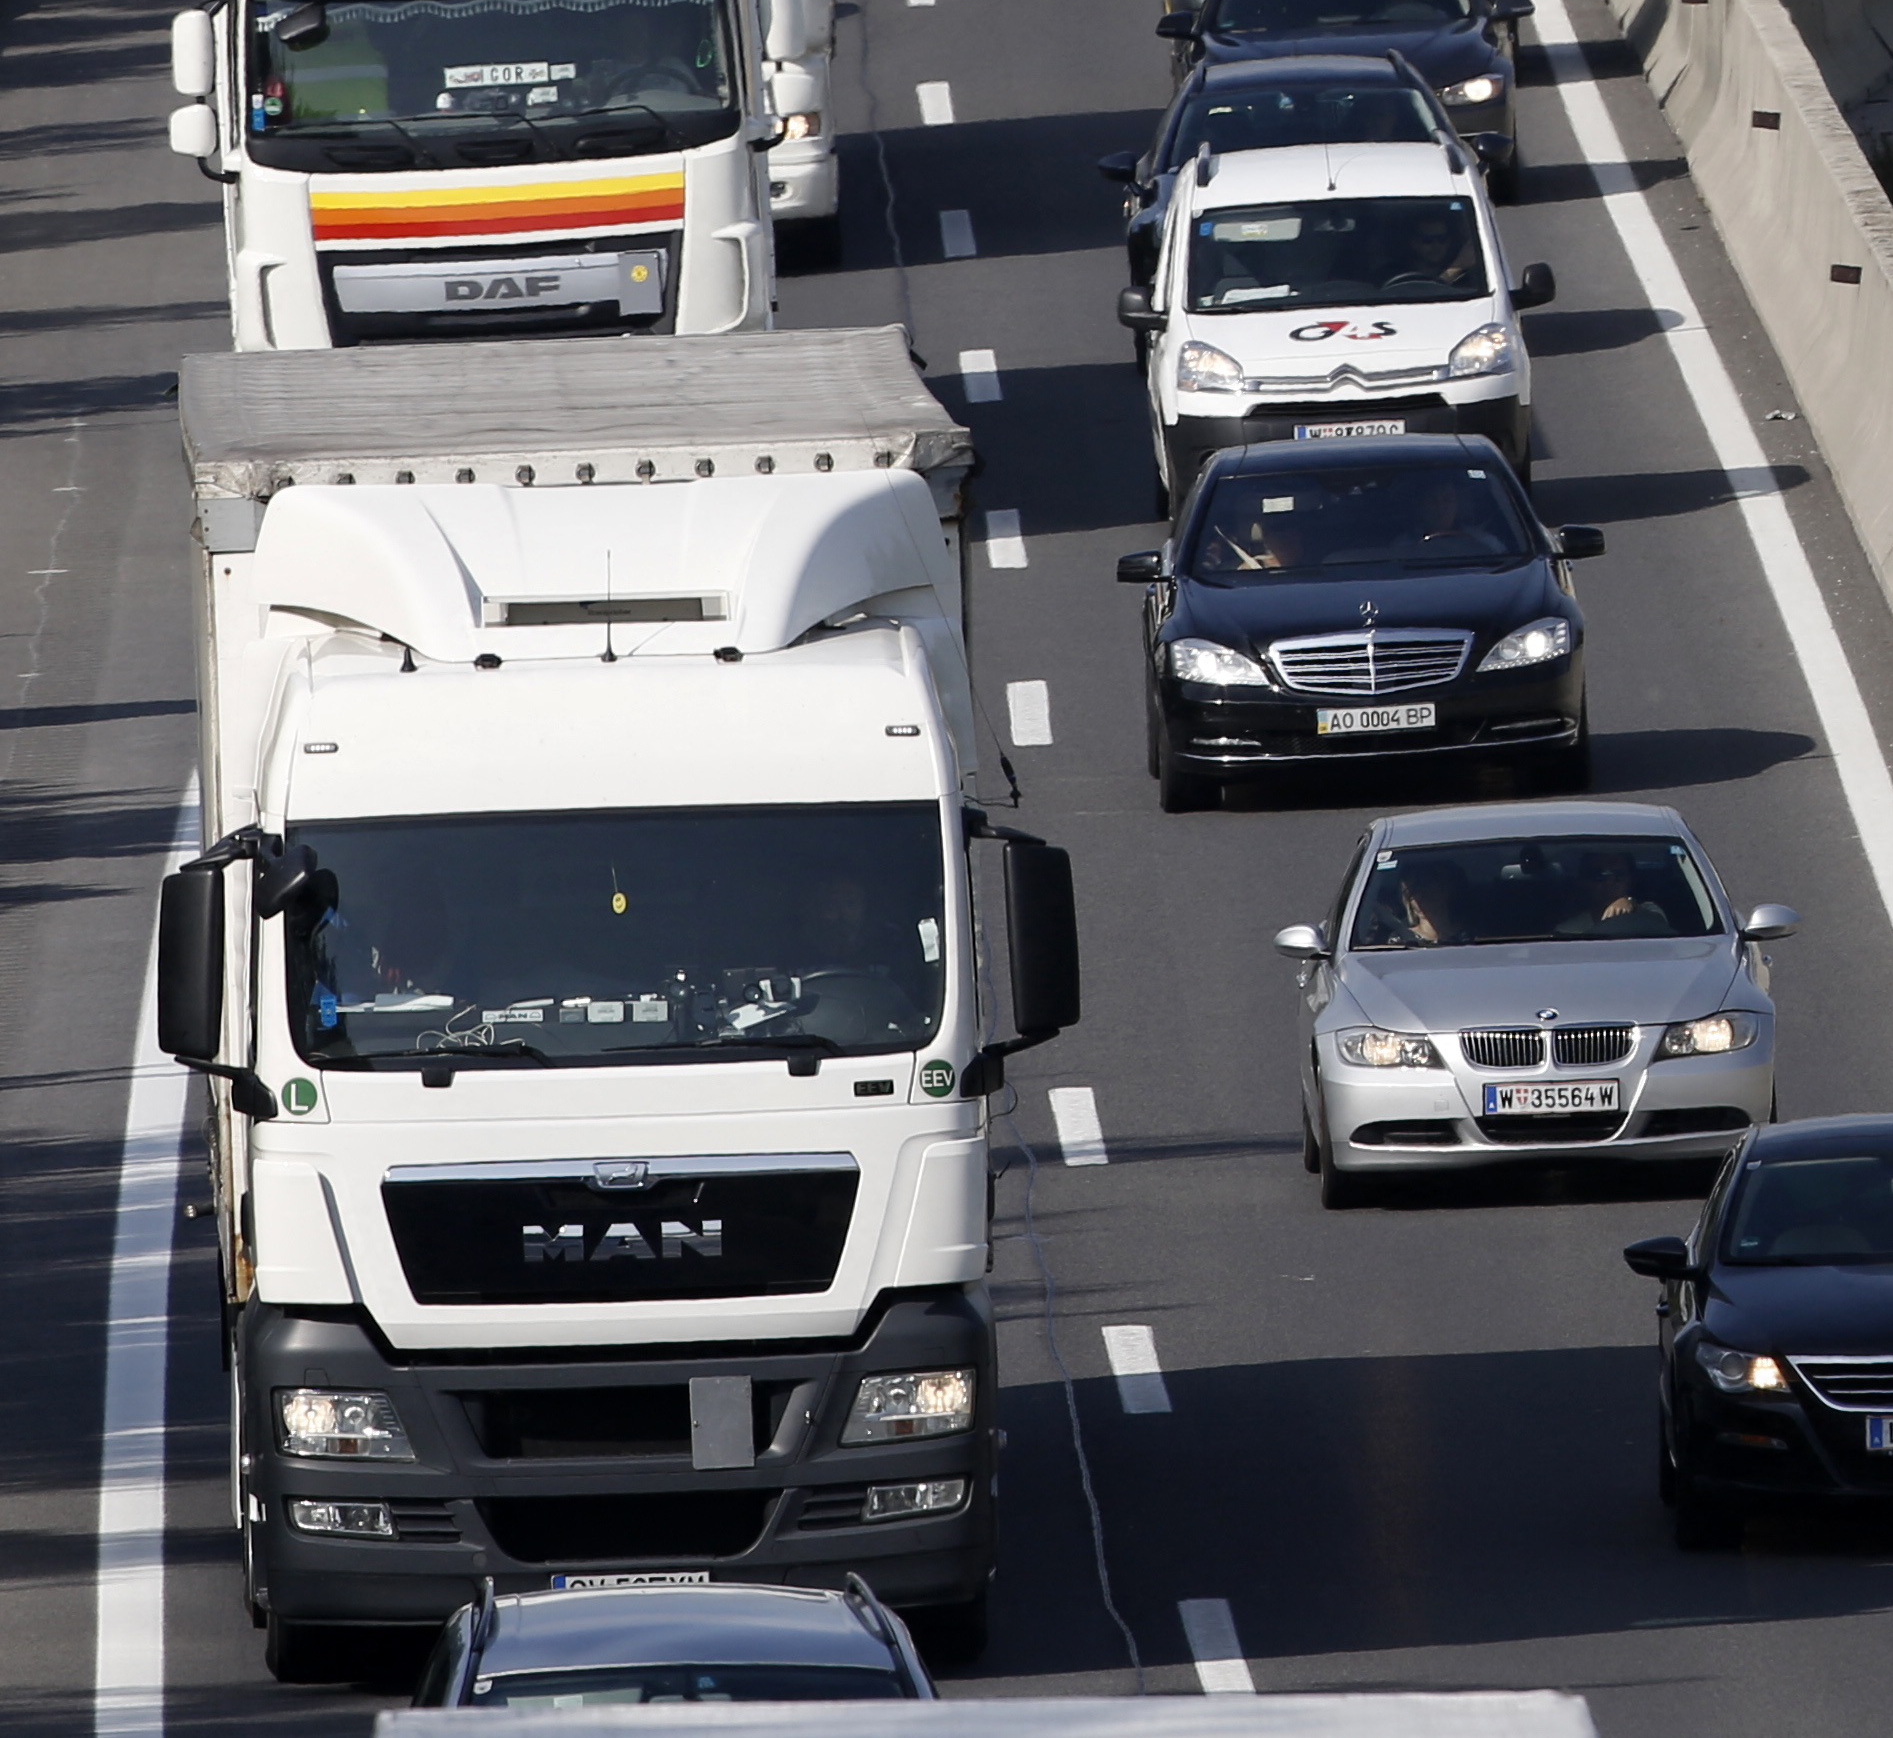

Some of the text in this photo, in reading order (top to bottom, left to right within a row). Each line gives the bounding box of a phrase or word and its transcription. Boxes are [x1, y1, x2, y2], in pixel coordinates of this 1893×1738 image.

[445, 276, 560, 302] DAF
[1289, 321, 1397, 342] G4S
[1330, 707, 1431, 730] AO 0004 BP
[921, 1069, 953, 1087] EEV
[291, 1083, 308, 1111] L
[1500, 1088, 1514, 1109] W
[1531, 1087, 1596, 1108] 35564
[1599, 1085, 1614, 1107] W
[523, 1219, 722, 1262] MAN
